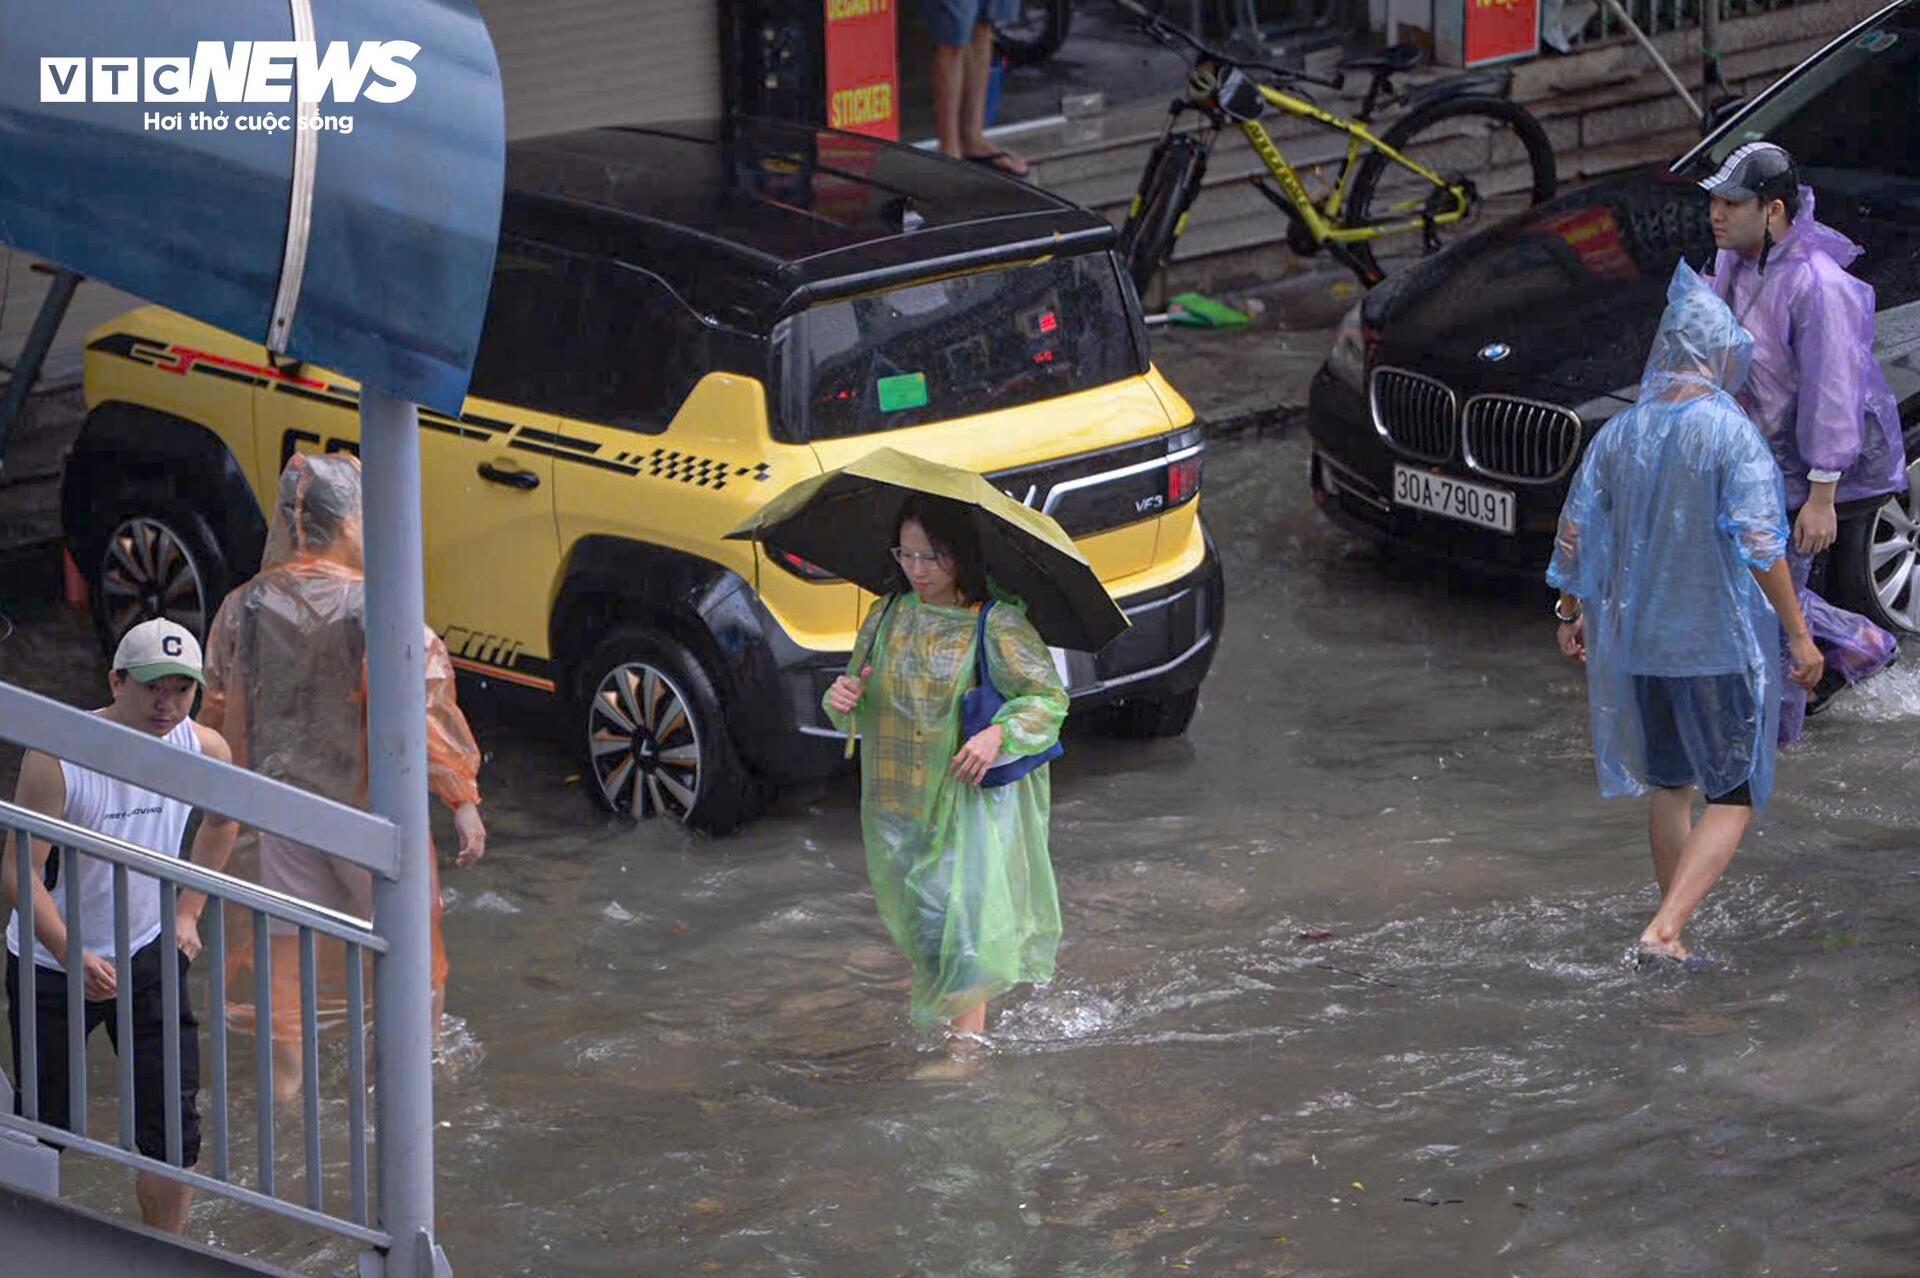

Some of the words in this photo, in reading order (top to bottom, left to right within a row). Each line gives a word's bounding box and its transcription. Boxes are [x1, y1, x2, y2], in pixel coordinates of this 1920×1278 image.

[831, 83, 892, 128] STICKER
[1397, 470, 1507, 527] 30A-790.91
[162, 636, 182, 656] C
